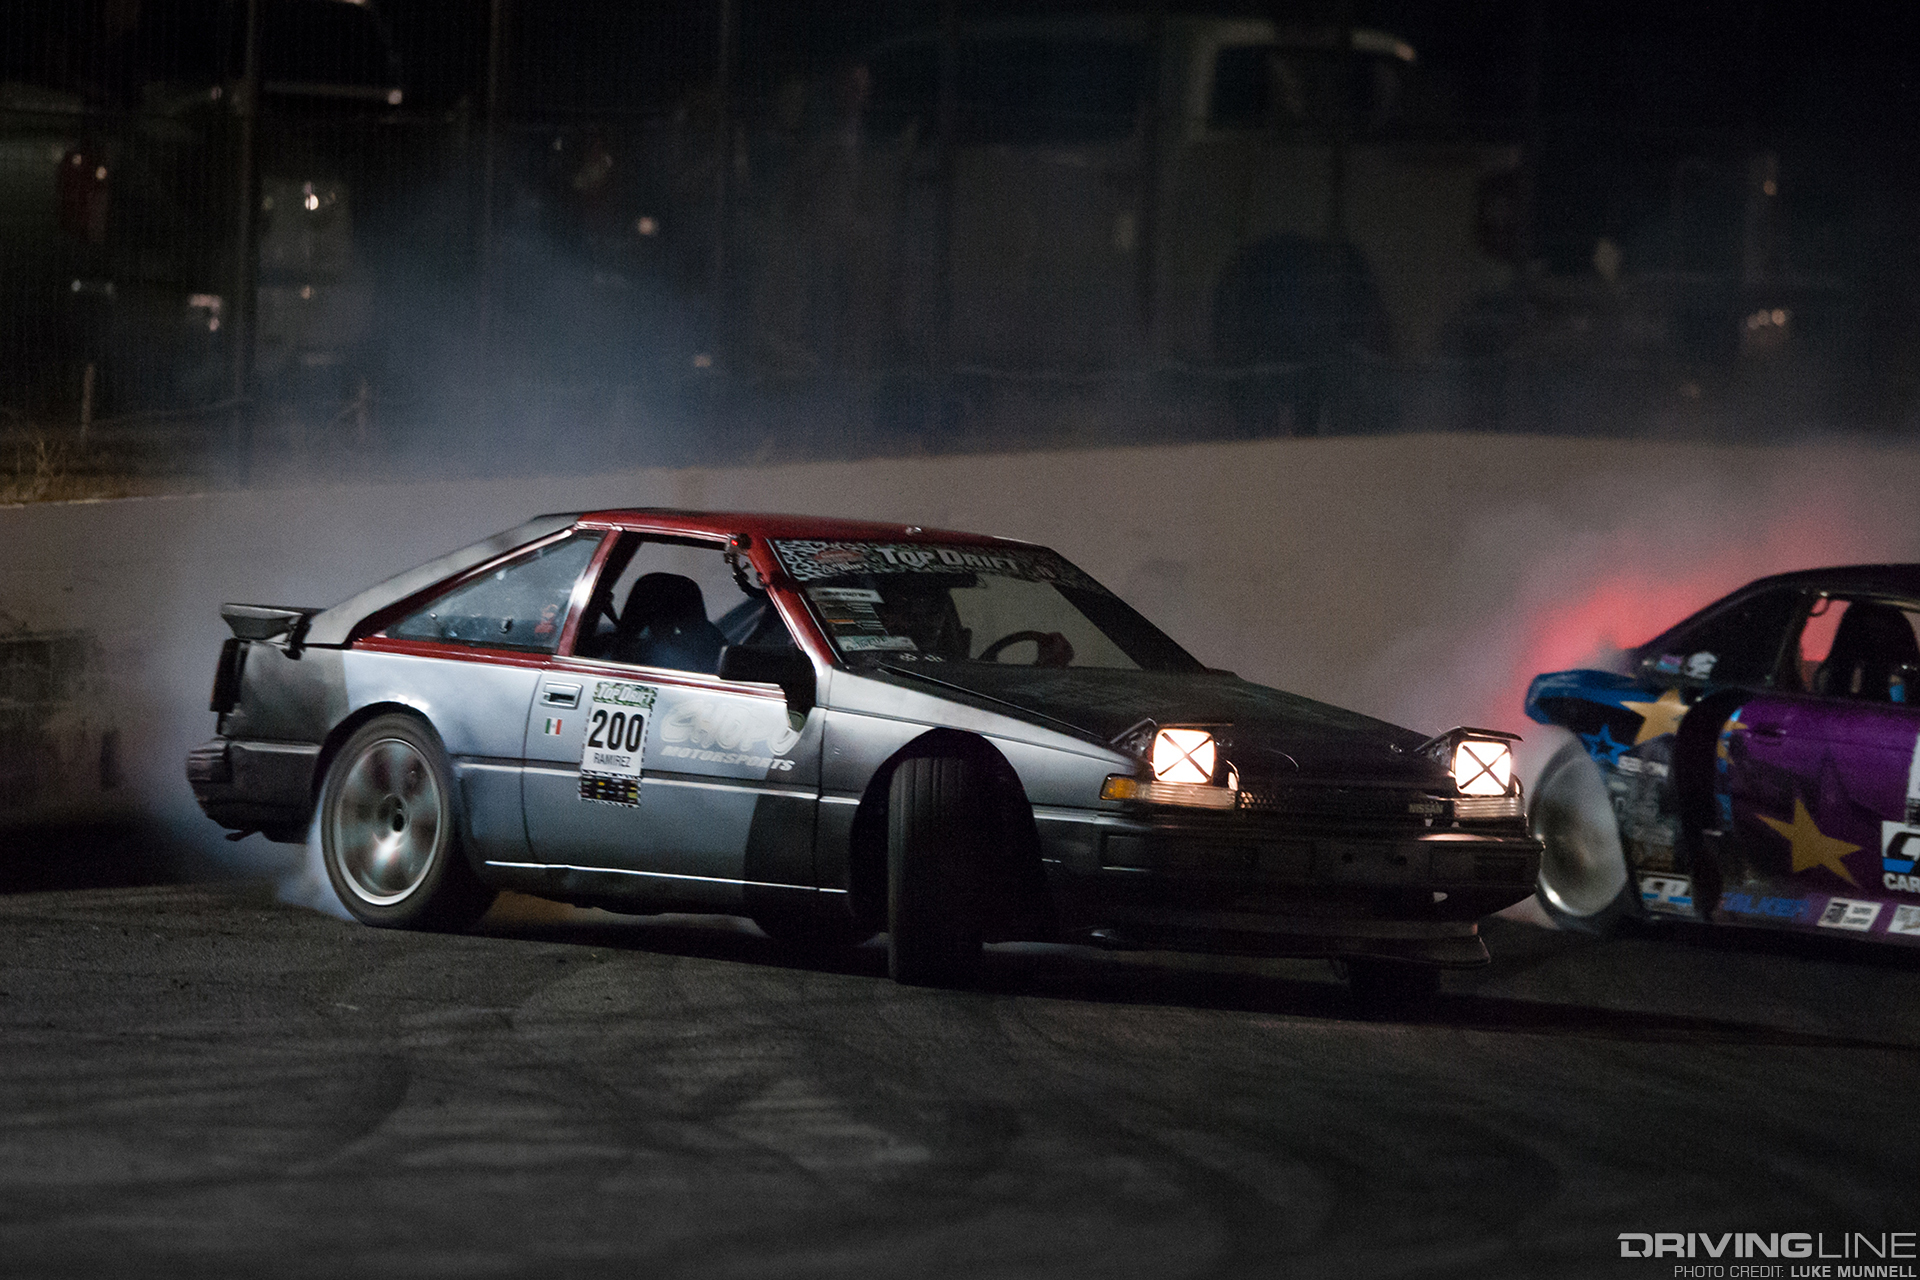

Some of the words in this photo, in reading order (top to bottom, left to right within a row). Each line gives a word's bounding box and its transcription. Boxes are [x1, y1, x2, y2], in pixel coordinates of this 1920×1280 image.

[876, 547, 938, 567] TOP
[939, 548, 1020, 572] DRIFT
[588, 708, 644, 753] 200
[593, 752, 631, 768] RAMIREZ
[660, 745, 796, 772] MOTORSPORTS
